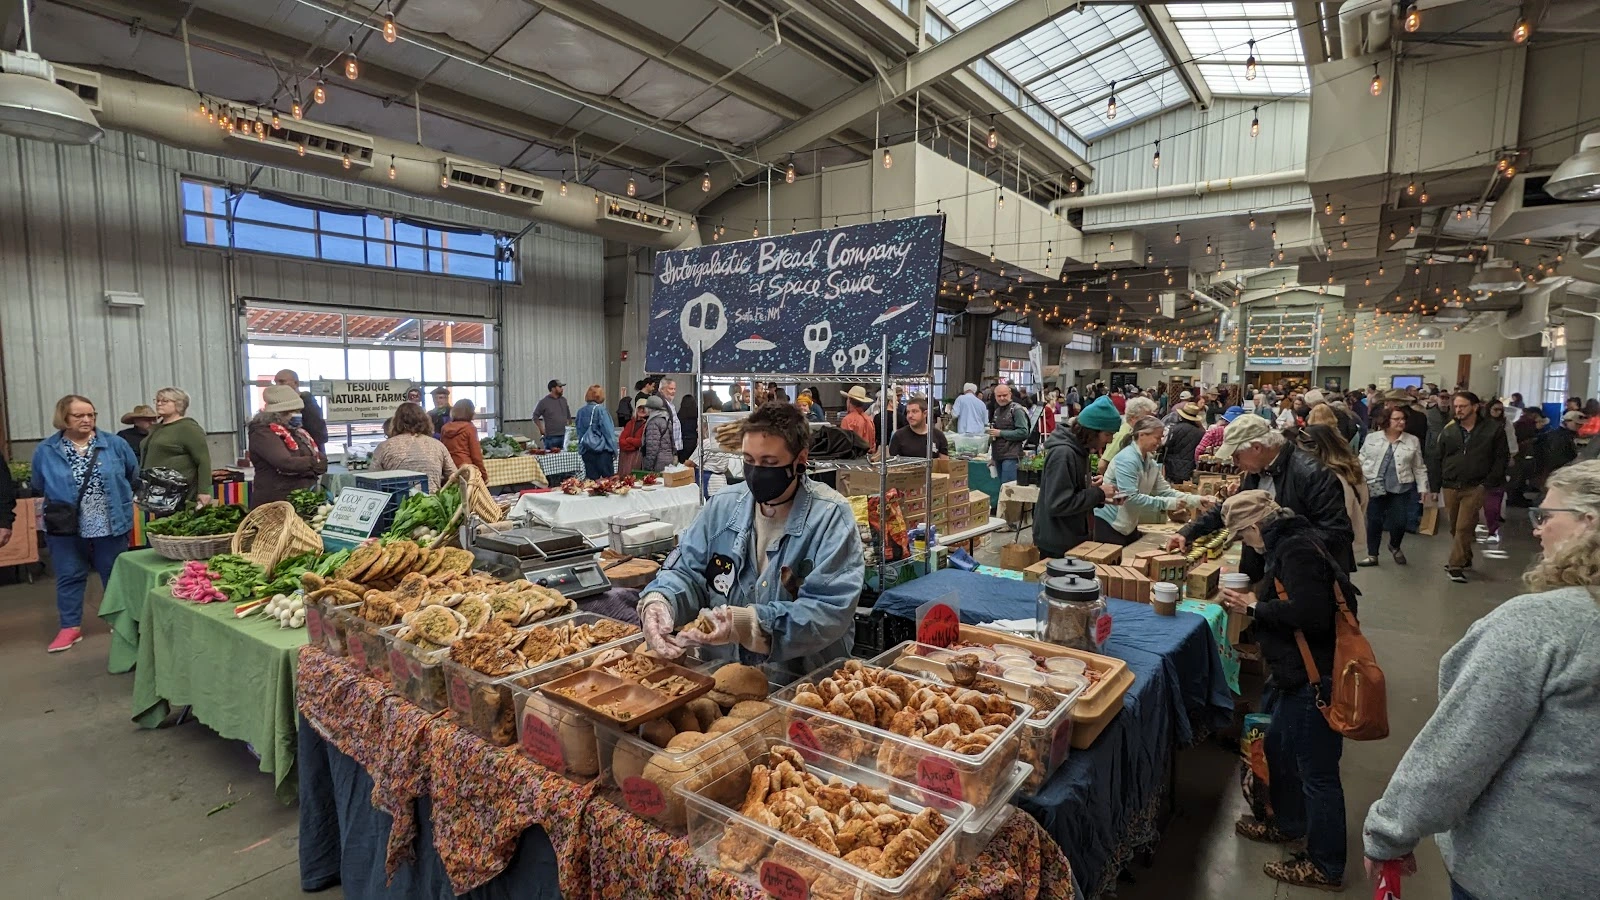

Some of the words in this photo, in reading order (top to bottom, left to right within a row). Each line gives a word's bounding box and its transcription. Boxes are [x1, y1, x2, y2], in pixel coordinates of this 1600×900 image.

[659, 249, 751, 288] Intergalactic
[757, 238, 822, 274] Bread
[827, 232, 912, 277] Company
[766, 273, 821, 309] Space
[824, 270, 883, 300] Sauce
[767, 306, 780, 321] NM
[1422, 341, 1443, 349] BOOTH
[347, 382, 390, 392] TESUQUE
[328, 393, 373, 404] NATURAL
[376, 392, 407, 403] FARMS
[342, 493, 363, 505] CCOF
[921, 766, 955, 787] Apricot
